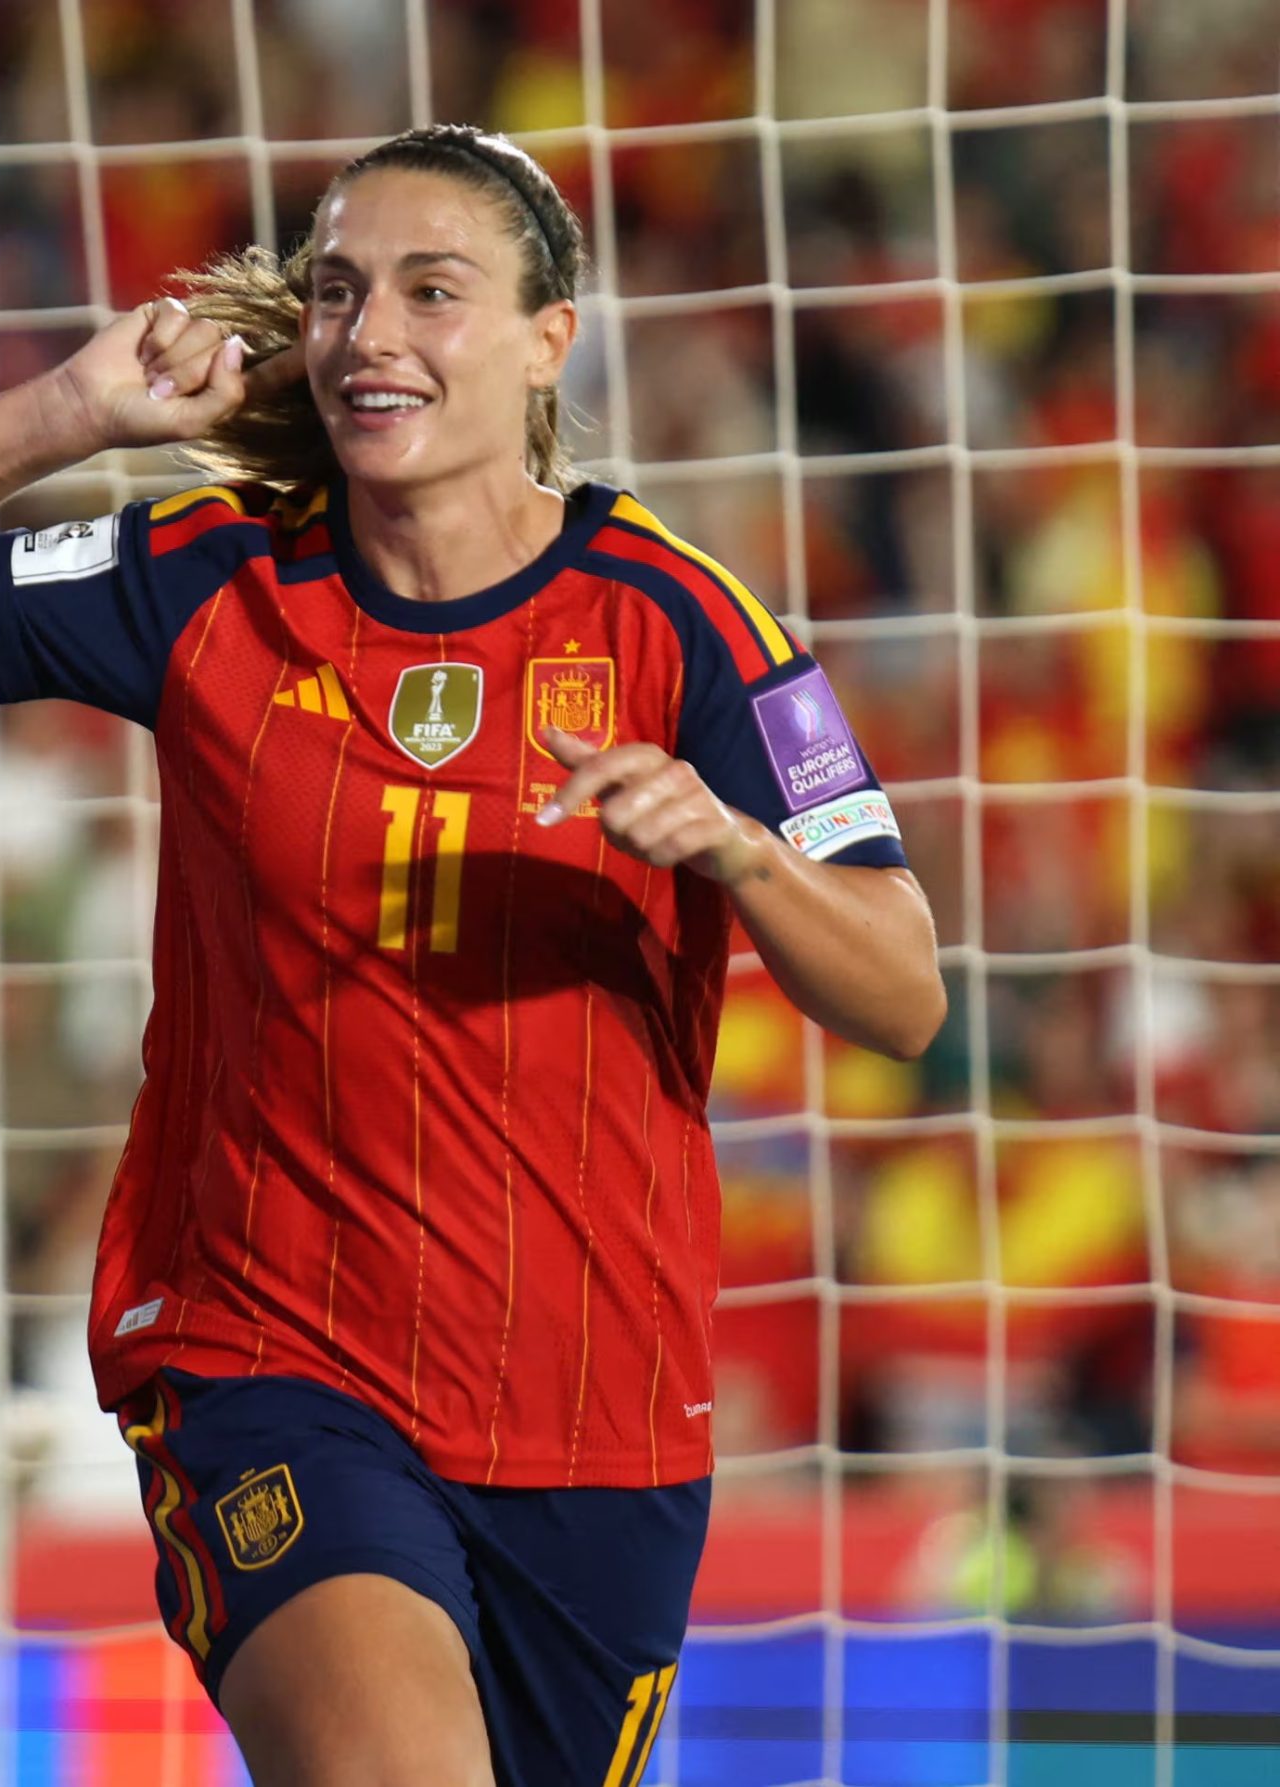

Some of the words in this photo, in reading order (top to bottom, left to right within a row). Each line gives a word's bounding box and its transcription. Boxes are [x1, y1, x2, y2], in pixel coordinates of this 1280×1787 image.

[413, 723, 453, 737] FIFA
[787, 742, 852, 780] EUROPEAN
[792, 756, 856, 794] QUALIFIERS
[792, 804, 892, 849] FOUNDATIO
[377, 784, 471, 953] 11
[602, 1662, 678, 1787] 11
